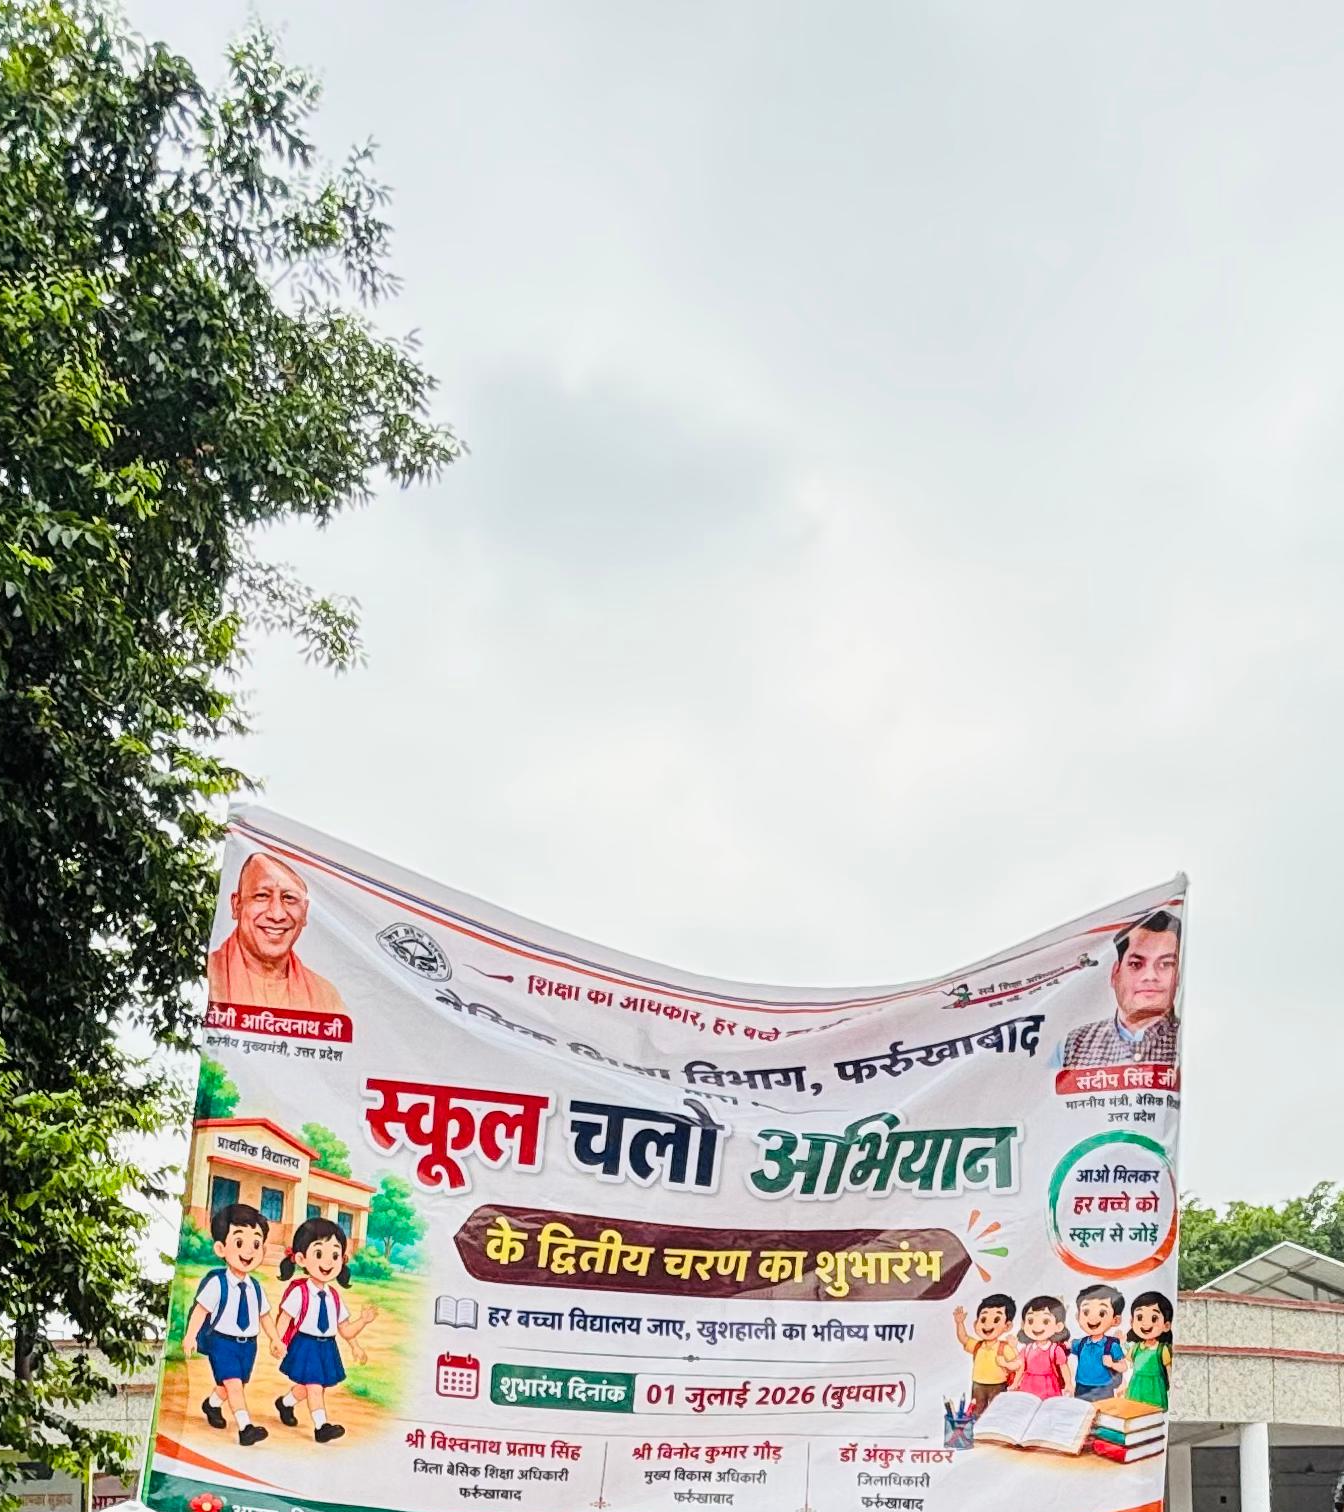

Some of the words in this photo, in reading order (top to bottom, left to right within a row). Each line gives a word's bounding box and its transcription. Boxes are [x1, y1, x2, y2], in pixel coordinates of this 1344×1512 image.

[682, 1060, 825, 1096] विभाग,
[365, 1078, 549, 1188] स्कूल
[570, 1097, 725, 1187] चलो
[753, 1111, 1018, 1195] अभियान
[485, 1216, 526, 1265] के
[536, 1229, 652, 1277] द्वितीय
[663, 1246, 748, 1283] चरण
[757, 1248, 805, 1283] का
[815, 1239, 943, 1297] शुभारंभ
[487, 1305, 511, 1329] हर
[517, 1309, 563, 1332] बच्चा
[568, 1310, 642, 1336] विद्यालय
[646, 1317, 691, 1343] जाए,
[697, 1316, 777, 1346] खुशहाली
[783, 1324, 806, 1342] का
[812, 1320, 869, 1343] भविष्य
[874, 1323, 915, 1344] पाए।
[499, 1374, 563, 1405] शुभारंभ
[568, 1376, 627, 1404] दिनांक
[646, 1384, 675, 1404] 01
[685, 1380, 751, 1414] जुलाई
[756, 1385, 815, 1406] 2026
[822, 1380, 907, 1410] (बुधवार)
